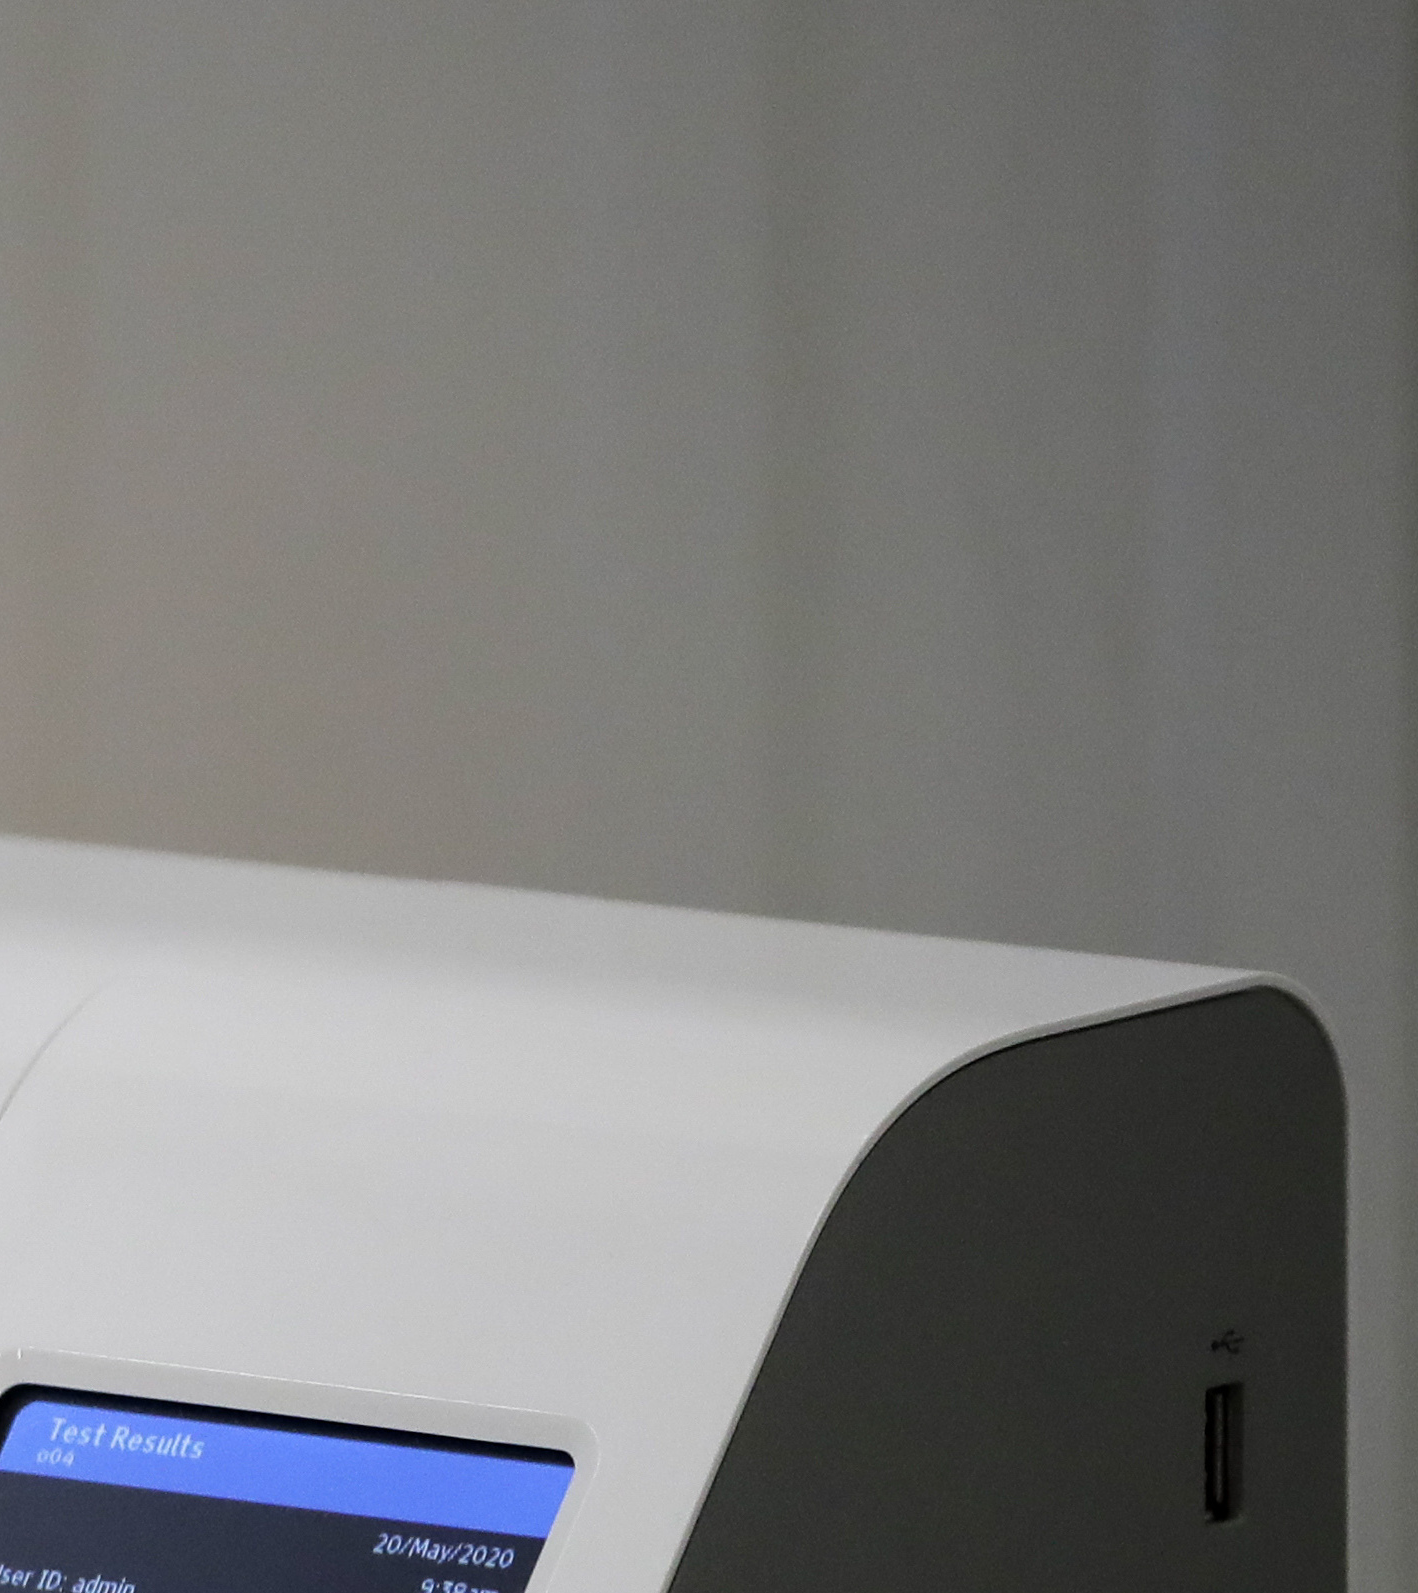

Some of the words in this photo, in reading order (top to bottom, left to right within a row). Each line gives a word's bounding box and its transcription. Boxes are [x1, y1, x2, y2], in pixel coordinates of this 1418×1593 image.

[49, 1417, 108, 1447] Test
[110, 1425, 207, 1459] Results
[373, 1533, 515, 1569] 20/May/2020
[36, 1569, 67, 1593] ID:
